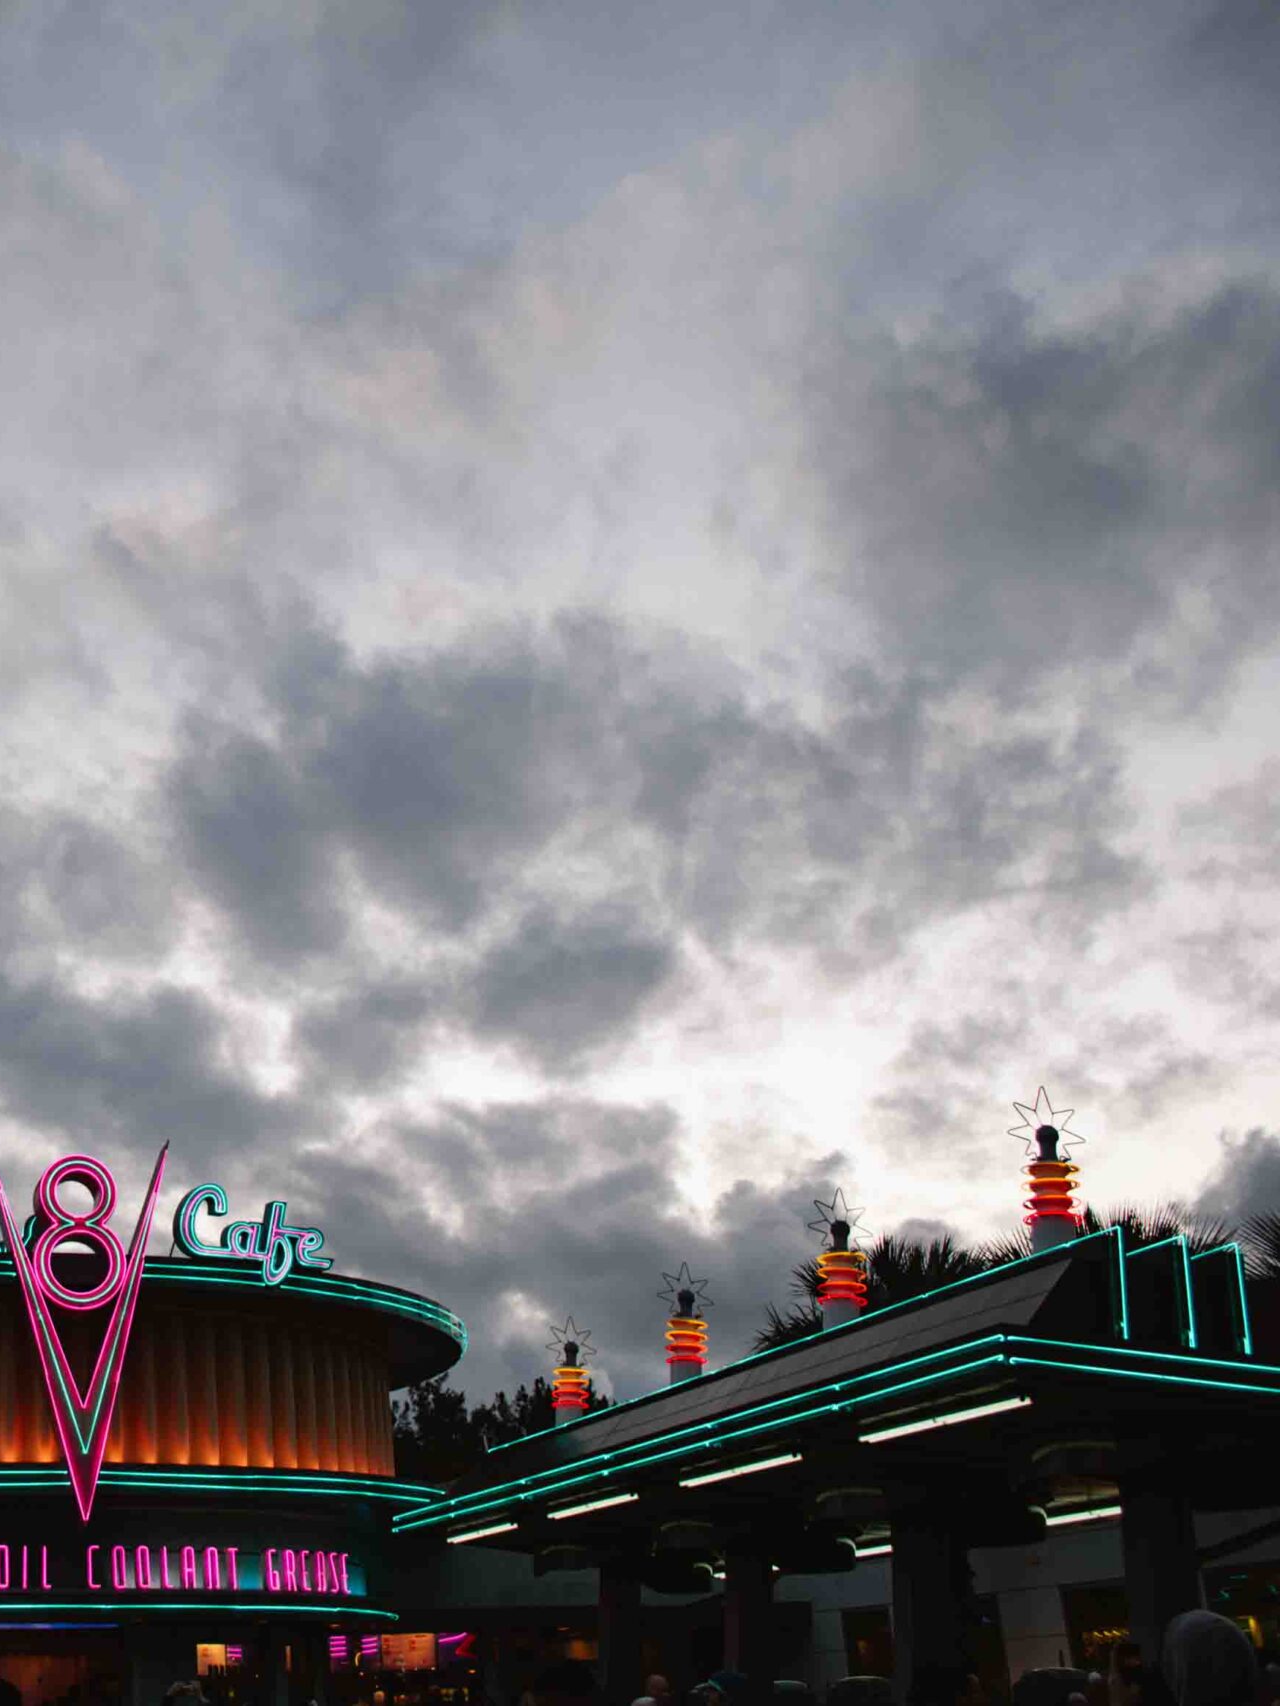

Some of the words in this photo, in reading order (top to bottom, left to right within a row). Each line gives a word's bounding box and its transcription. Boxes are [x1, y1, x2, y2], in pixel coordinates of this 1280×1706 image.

[174, 1182, 335, 1287] Cafe
[86, 1544, 239, 1592] COOLANT
[266, 1547, 352, 1595] GREASE
